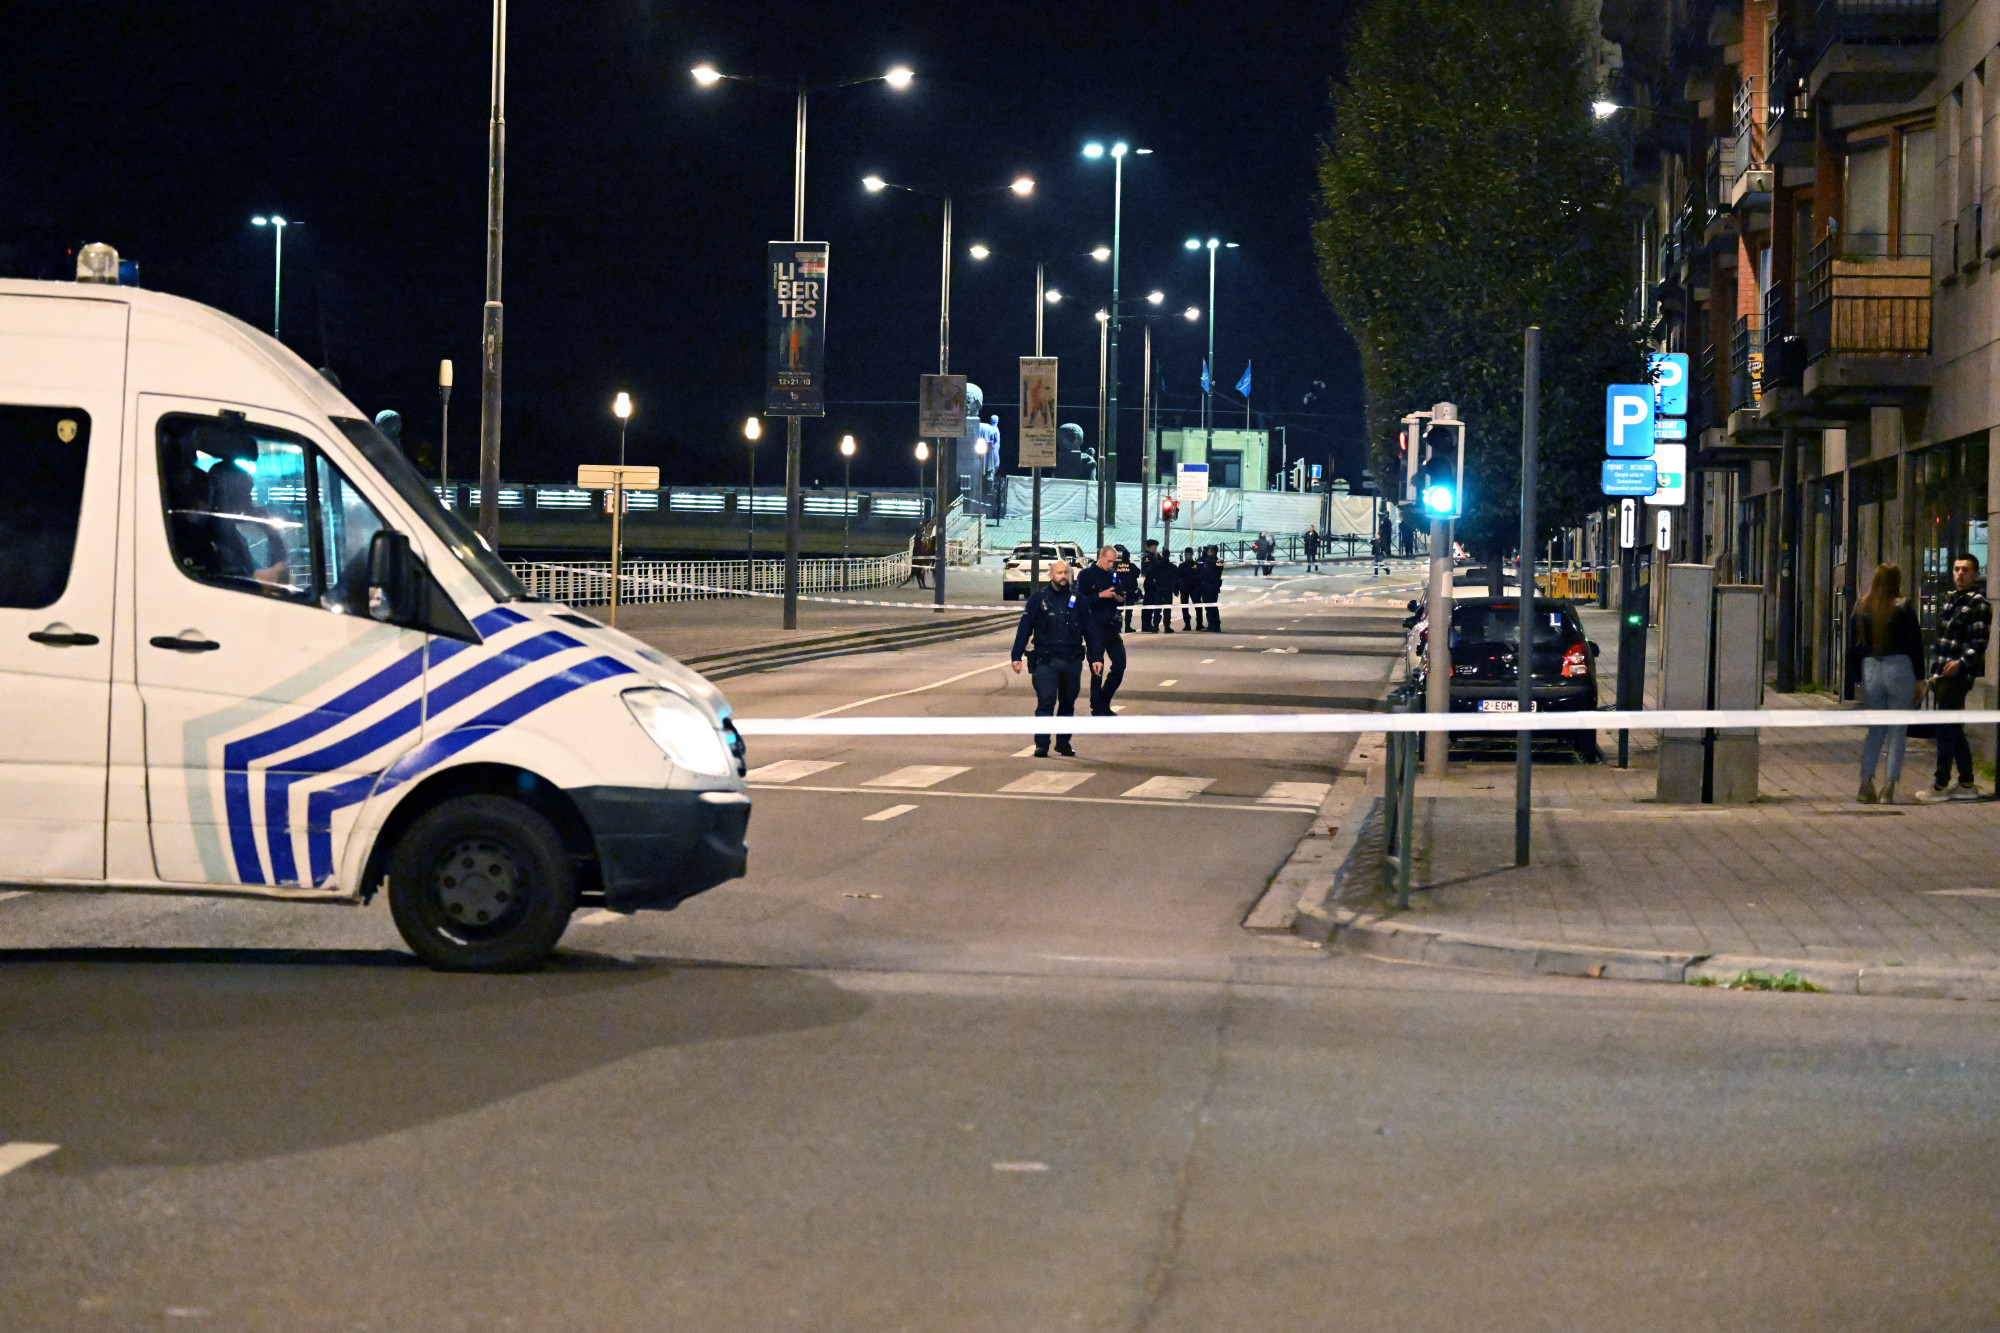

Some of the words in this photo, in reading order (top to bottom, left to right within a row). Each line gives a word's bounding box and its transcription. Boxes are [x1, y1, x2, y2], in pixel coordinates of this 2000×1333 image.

[778, 262, 795, 280] LI
[778, 281, 819, 299] BER
[1652, 361, 1683, 403] P
[1613, 395, 1648, 445] P
[1655, 421, 1678, 429] PAYANT
[1655, 430, 1682, 438] ETALEND
[1550, 613, 1561, 626] L
